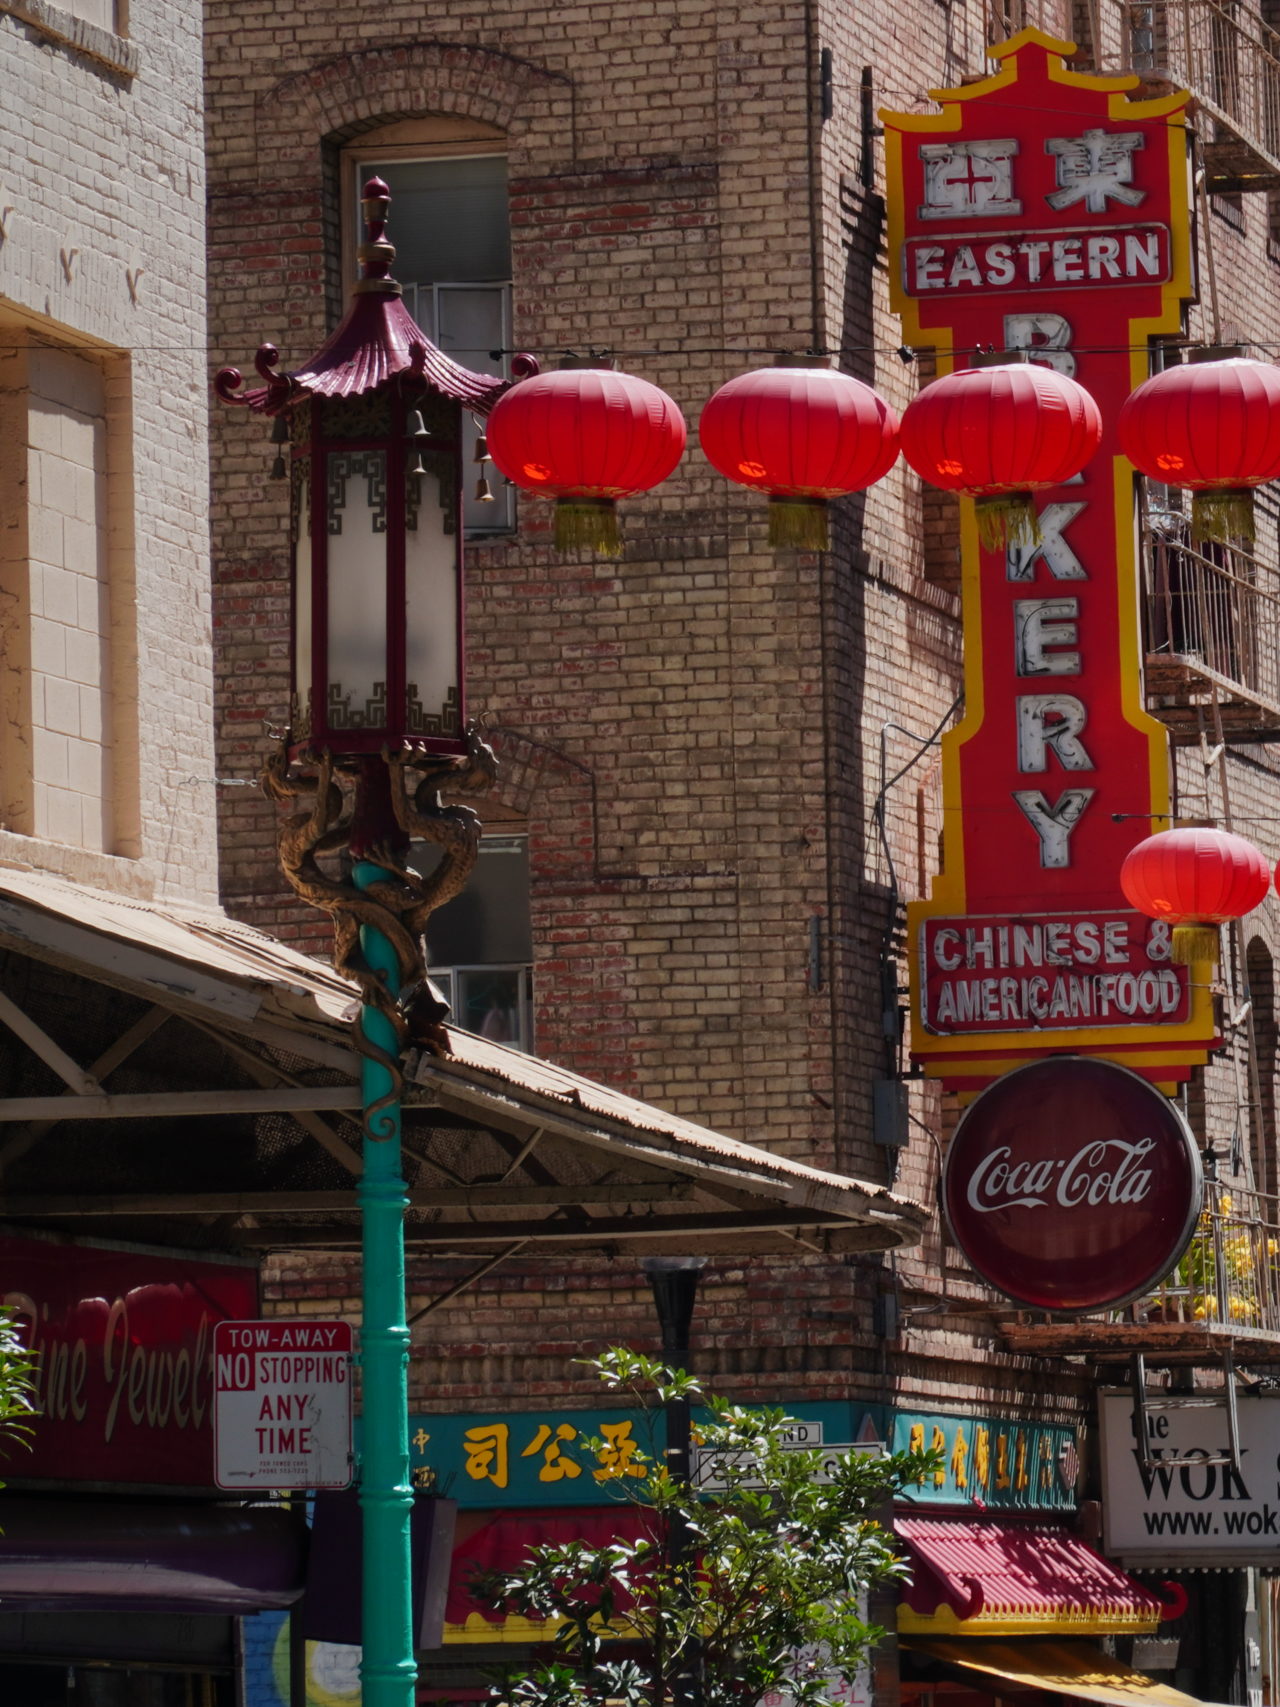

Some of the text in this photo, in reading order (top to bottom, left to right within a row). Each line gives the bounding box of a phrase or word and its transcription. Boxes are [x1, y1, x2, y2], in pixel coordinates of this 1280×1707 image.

[916, 233, 1160, 290] EASTERN
[1004, 313, 1095, 869] BKERY
[934, 920, 1173, 970] CHINESE &
[938, 969, 1181, 1022] AMERICAN FOOD
[967, 1137, 1157, 1212] Coca-Cola
[228, 1328, 337, 1348] TOW-AWAY
[217, 1353, 345, 1388] NO STOPPING
[259, 1395, 308, 1420] ANY
[255, 1428, 311, 1453] TIME
[1131, 1447, 1253, 1502] WOK
